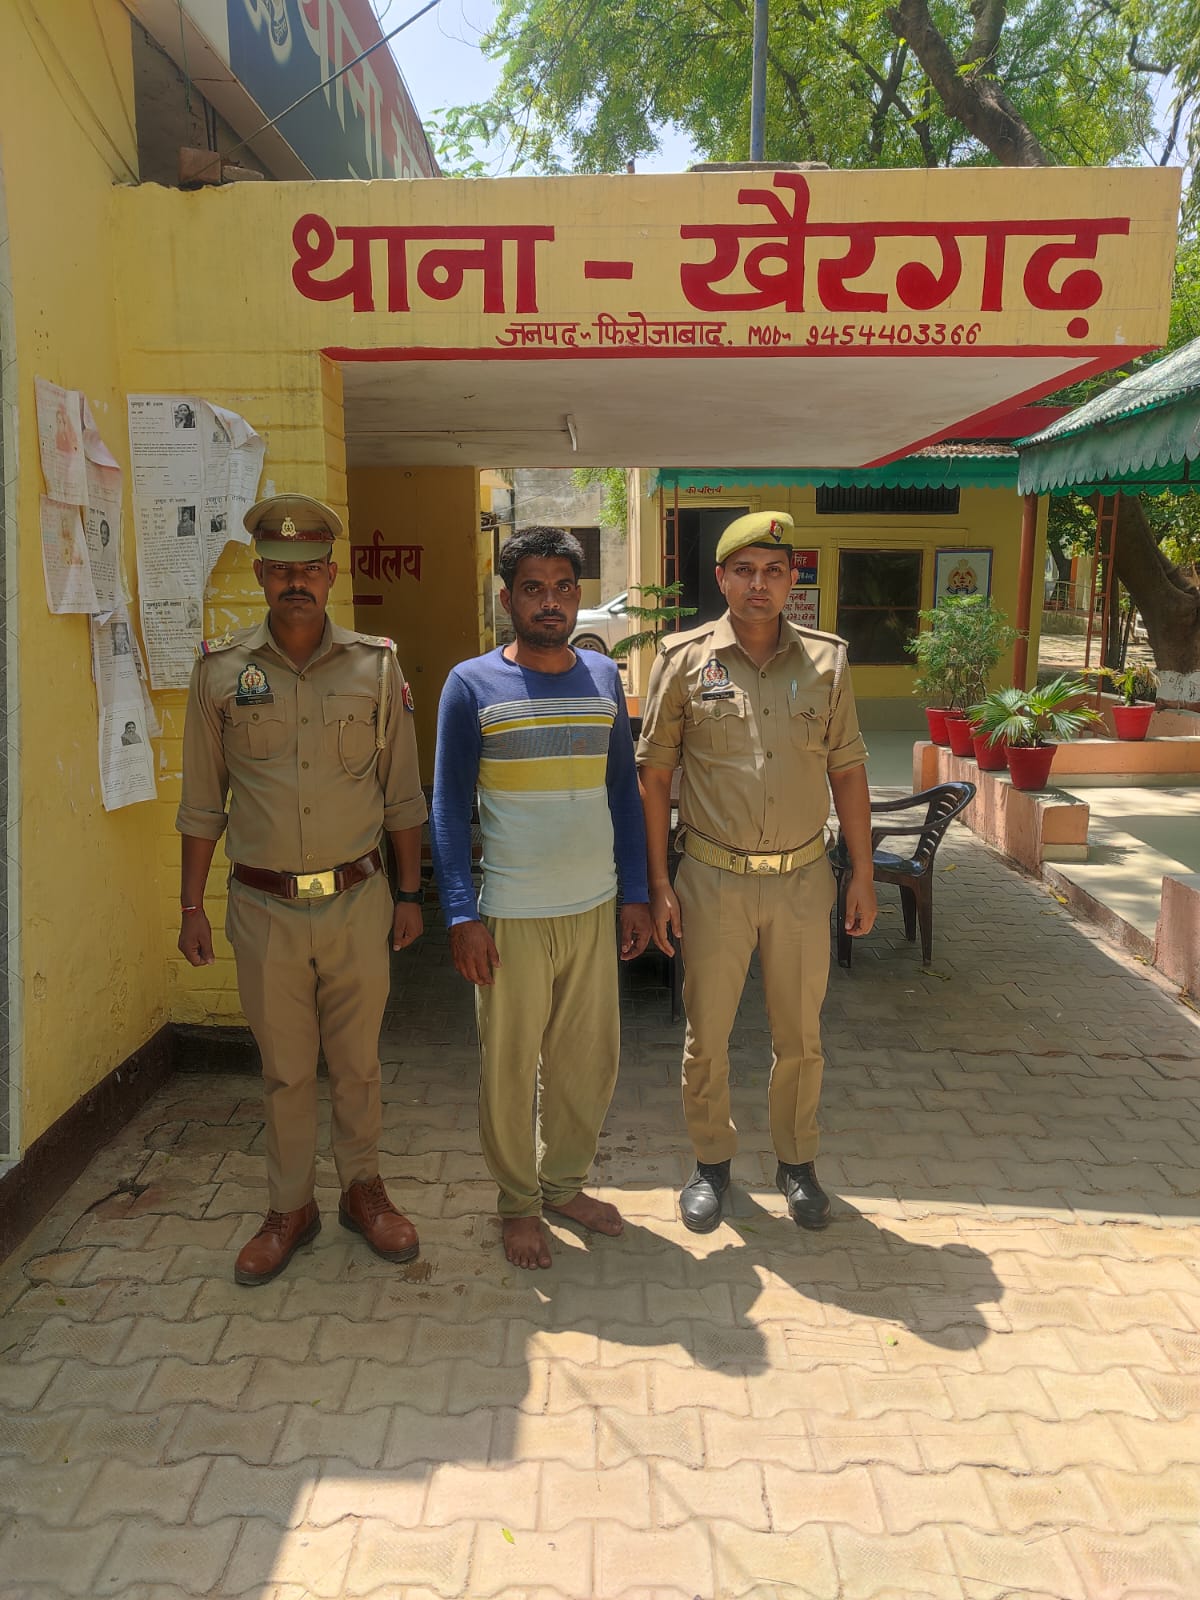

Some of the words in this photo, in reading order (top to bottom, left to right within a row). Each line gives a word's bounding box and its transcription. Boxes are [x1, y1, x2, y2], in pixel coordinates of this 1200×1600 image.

[292, 213, 555, 314] थाना
[680, 171, 1131, 339] खैरगढ़
[805, 322, 982, 346] 9454403366
[350, 529, 425, 584] ार्यालय
